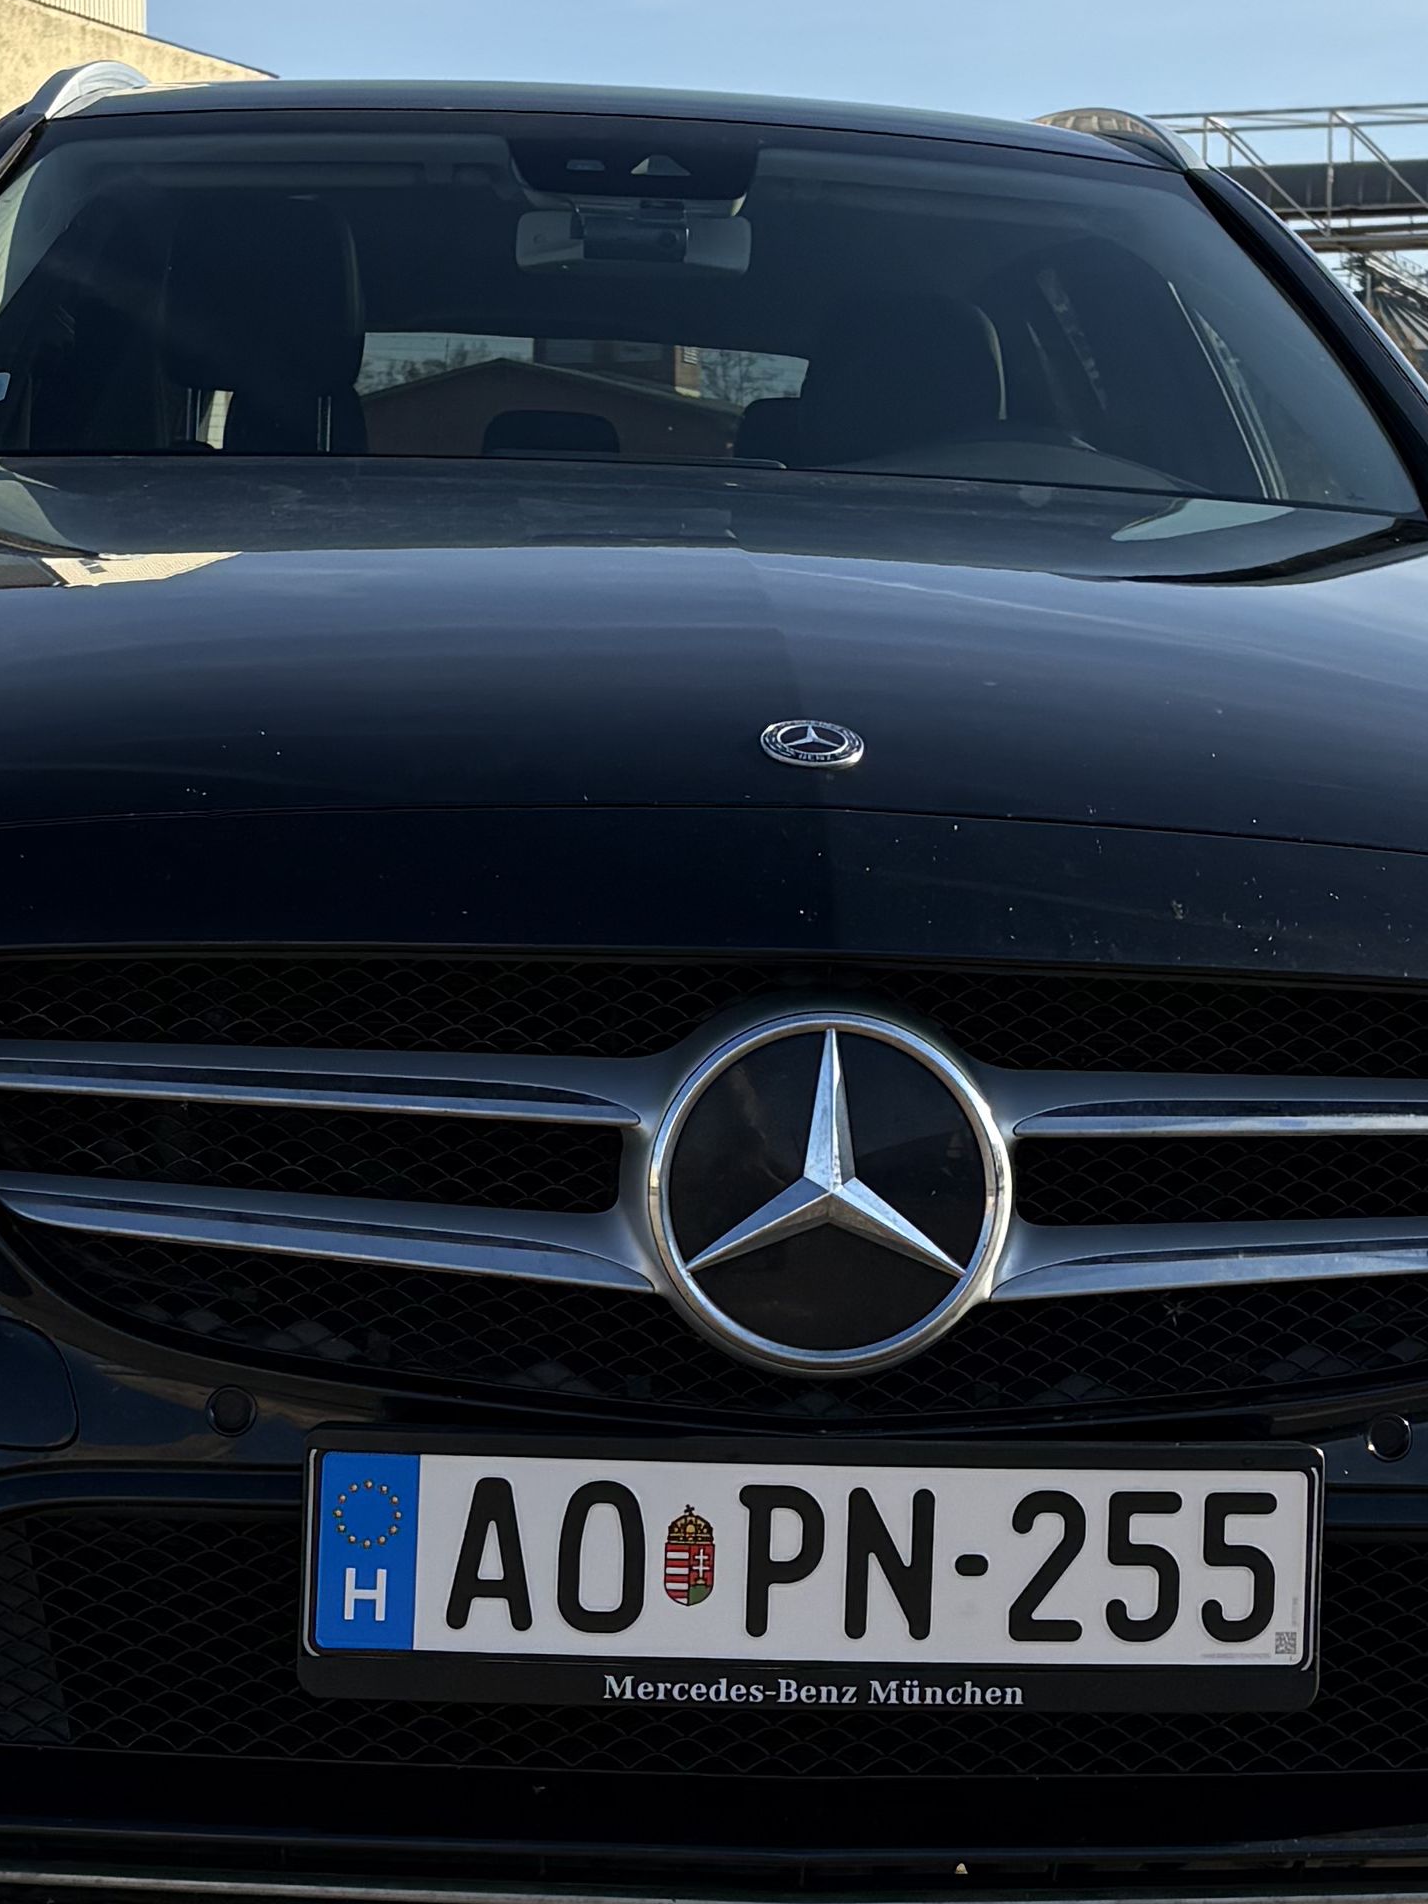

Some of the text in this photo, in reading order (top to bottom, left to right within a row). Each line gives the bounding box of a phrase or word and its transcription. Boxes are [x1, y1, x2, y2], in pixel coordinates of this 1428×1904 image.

[446, 1477, 1278, 1643] AO PN-255
[344, 1568, 387, 1621] H
[603, 1674, 1024, 1705] Mercedes-Benz München
